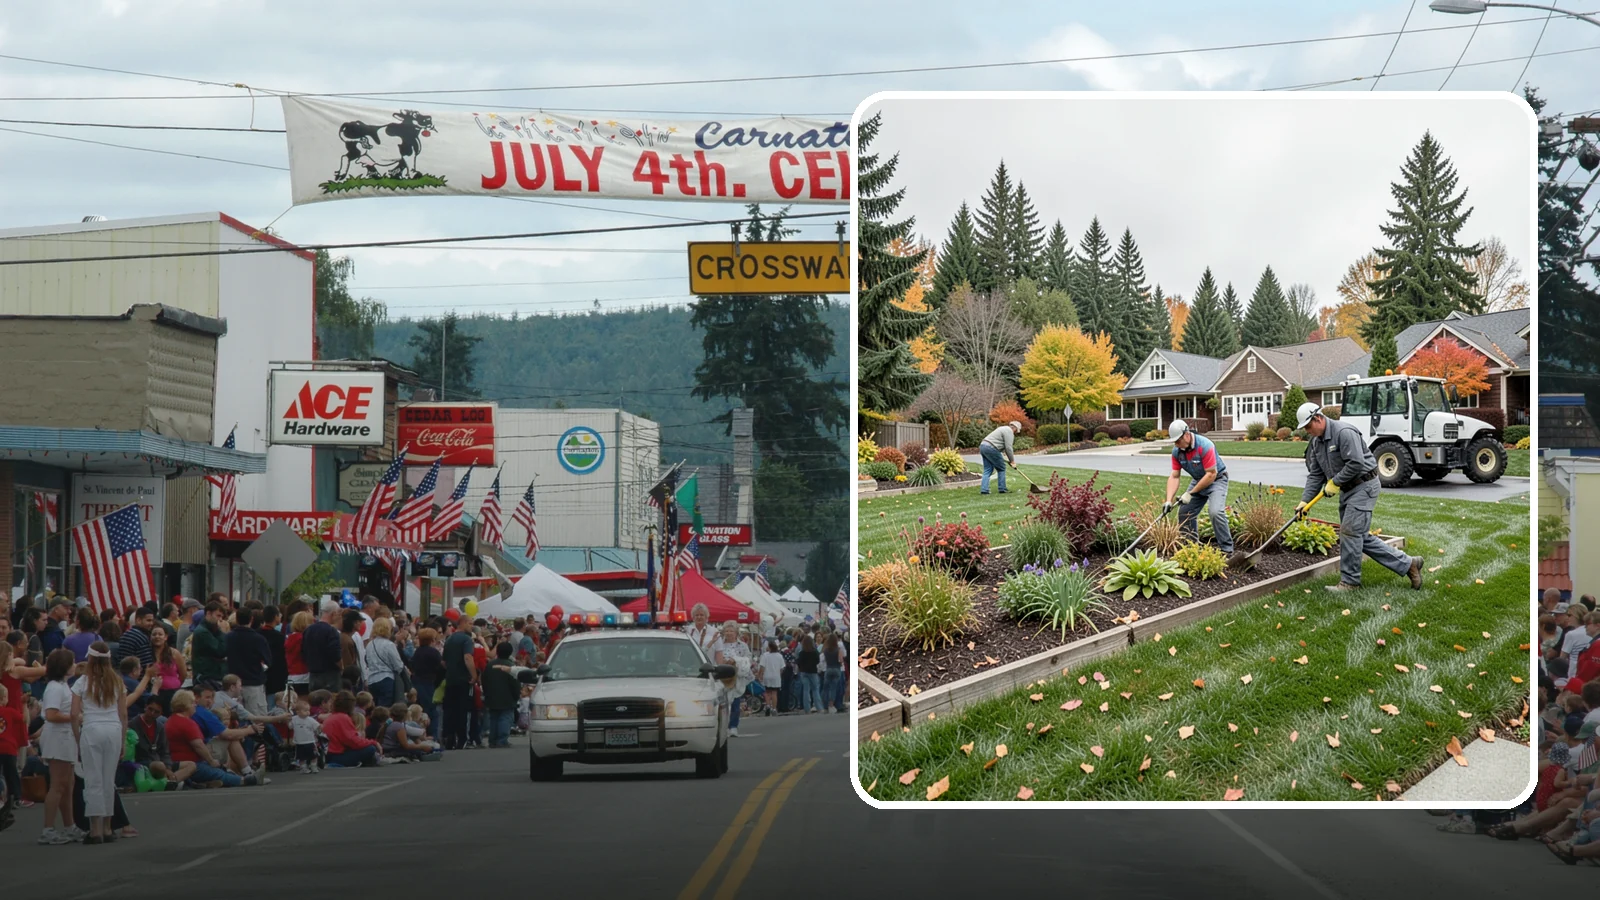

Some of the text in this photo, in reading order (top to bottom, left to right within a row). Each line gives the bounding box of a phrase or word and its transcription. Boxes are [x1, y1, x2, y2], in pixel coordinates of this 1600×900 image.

[695, 121, 849, 150] Carnat
[481, 141, 605, 193] JULY
[632, 150, 747, 198] 4th.
[697, 254, 849, 280] CROSSWA
[282, 380, 374, 420] ACE
[405, 409, 453, 422] CEDAR
[283, 421, 371, 437] Hardware
[353, 467, 384, 480] Simpl
[83, 484, 155, 495] St. Vincent de Paul
[688, 526, 741, 535] CRNATION
[699, 535, 730, 543] GLASS
